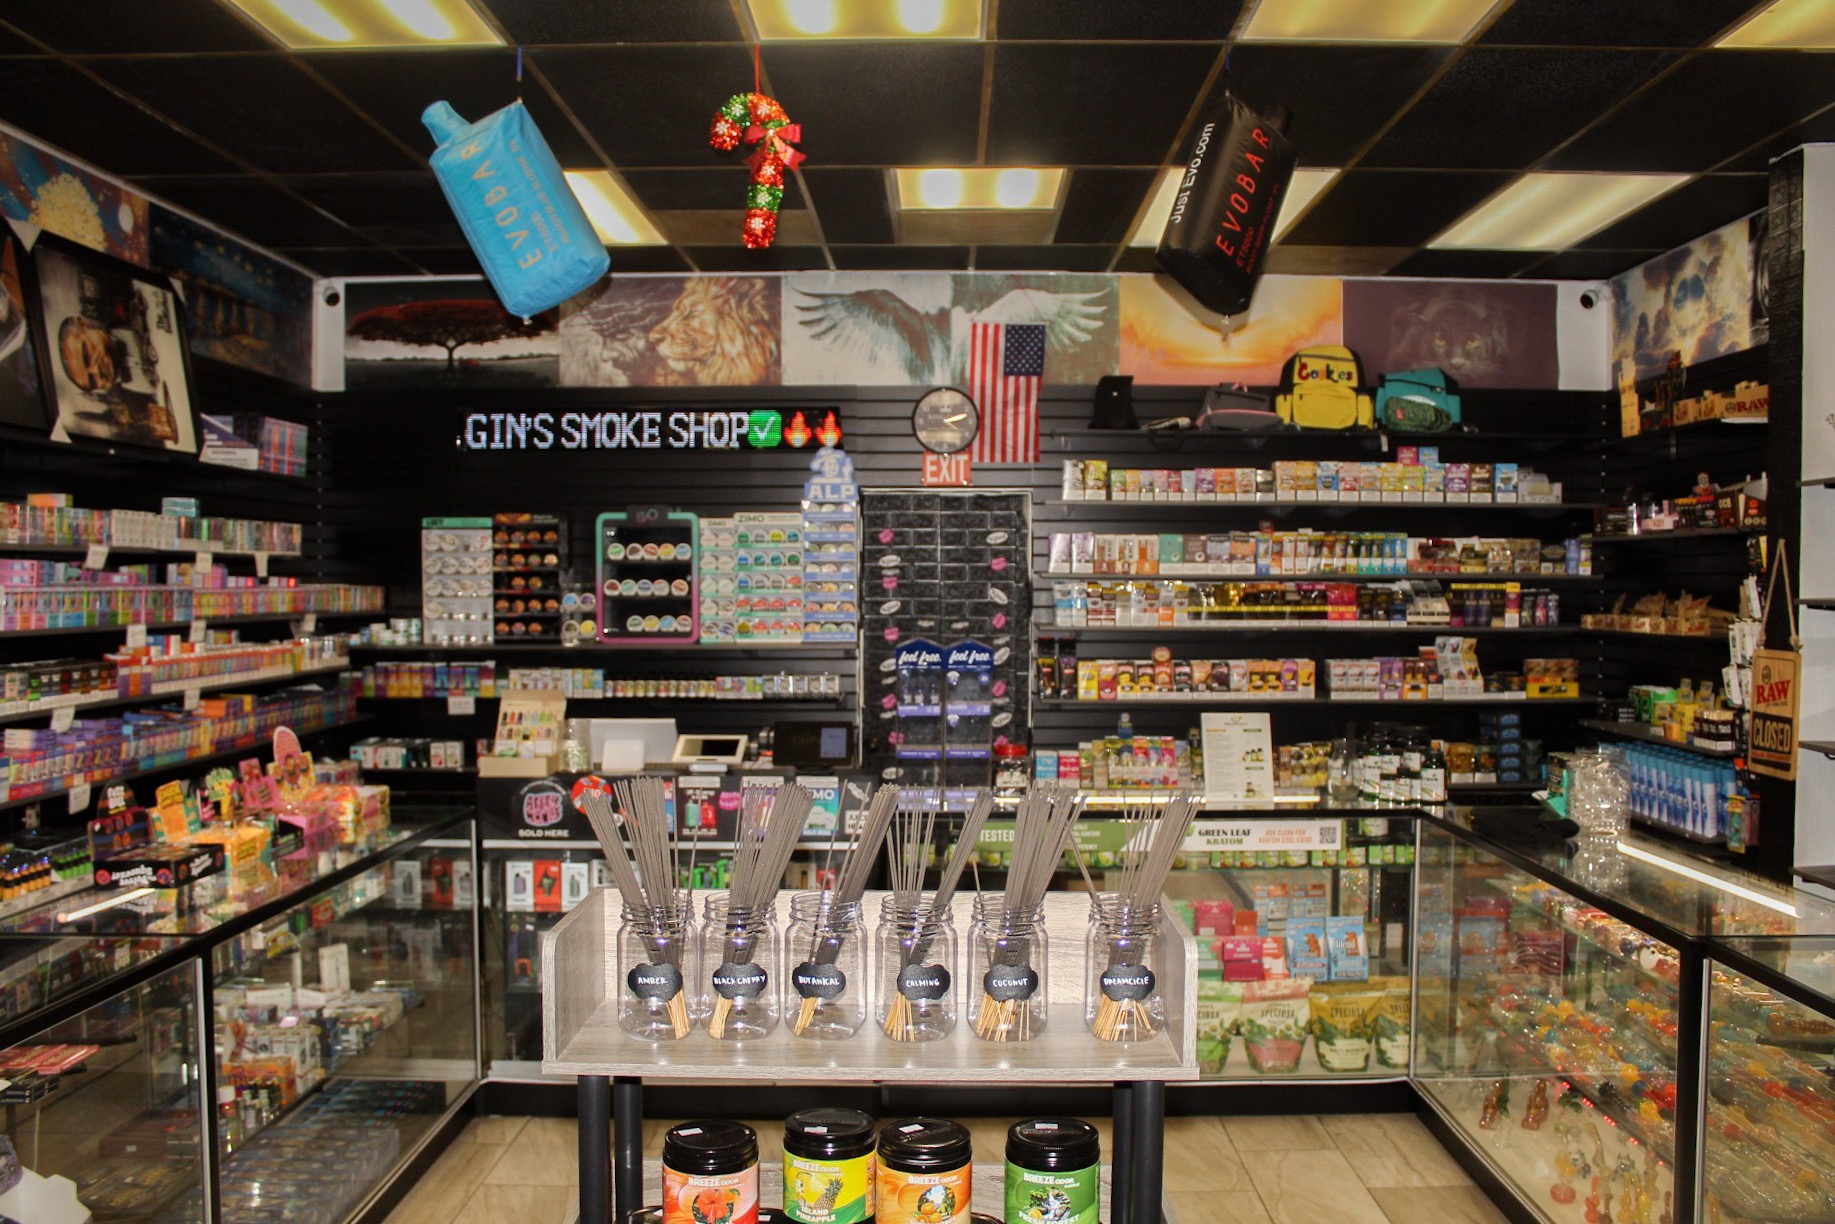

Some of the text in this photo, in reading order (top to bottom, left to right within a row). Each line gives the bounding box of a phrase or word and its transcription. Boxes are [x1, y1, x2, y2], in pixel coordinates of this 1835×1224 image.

[1216, 127, 1271, 257] EVOBAR
[460, 137, 543, 270] EVOBAR
[1298, 362, 1353, 384] Cookies
[465, 412, 749, 450] GIN'S SMOKE SHOP
[926, 455, 969, 483] EXIT
[809, 484, 855, 499] ALP
[738, 514, 765, 523] ZIMO
[898, 650, 919, 665] feel
[948, 650, 969, 664] feel
[1756, 680, 1792, 705] RAW
[1753, 718, 1792, 753] CLOSED
[518, 829, 569, 837] SOLD HERE
[980, 830, 1015, 842] TESTED
[1198, 829, 1252, 837] GREEN LEAF
[798, 976, 840, 986] BOTANICAL
[905, 979, 940, 987] CALMING
[993, 978, 1028, 987] COCONUT
[793, 1159, 820, 1173] BREEZE
[688, 1177, 739, 1187] BREEZE ODOR
[908, 1175, 958, 1185] BREEZE ODOR
[1023, 1172, 1075, 1185] BREEZE ODOR
[796, 1209, 836, 1223] PINEAPPLE
[801, 1206, 829, 1216] ISLAND
